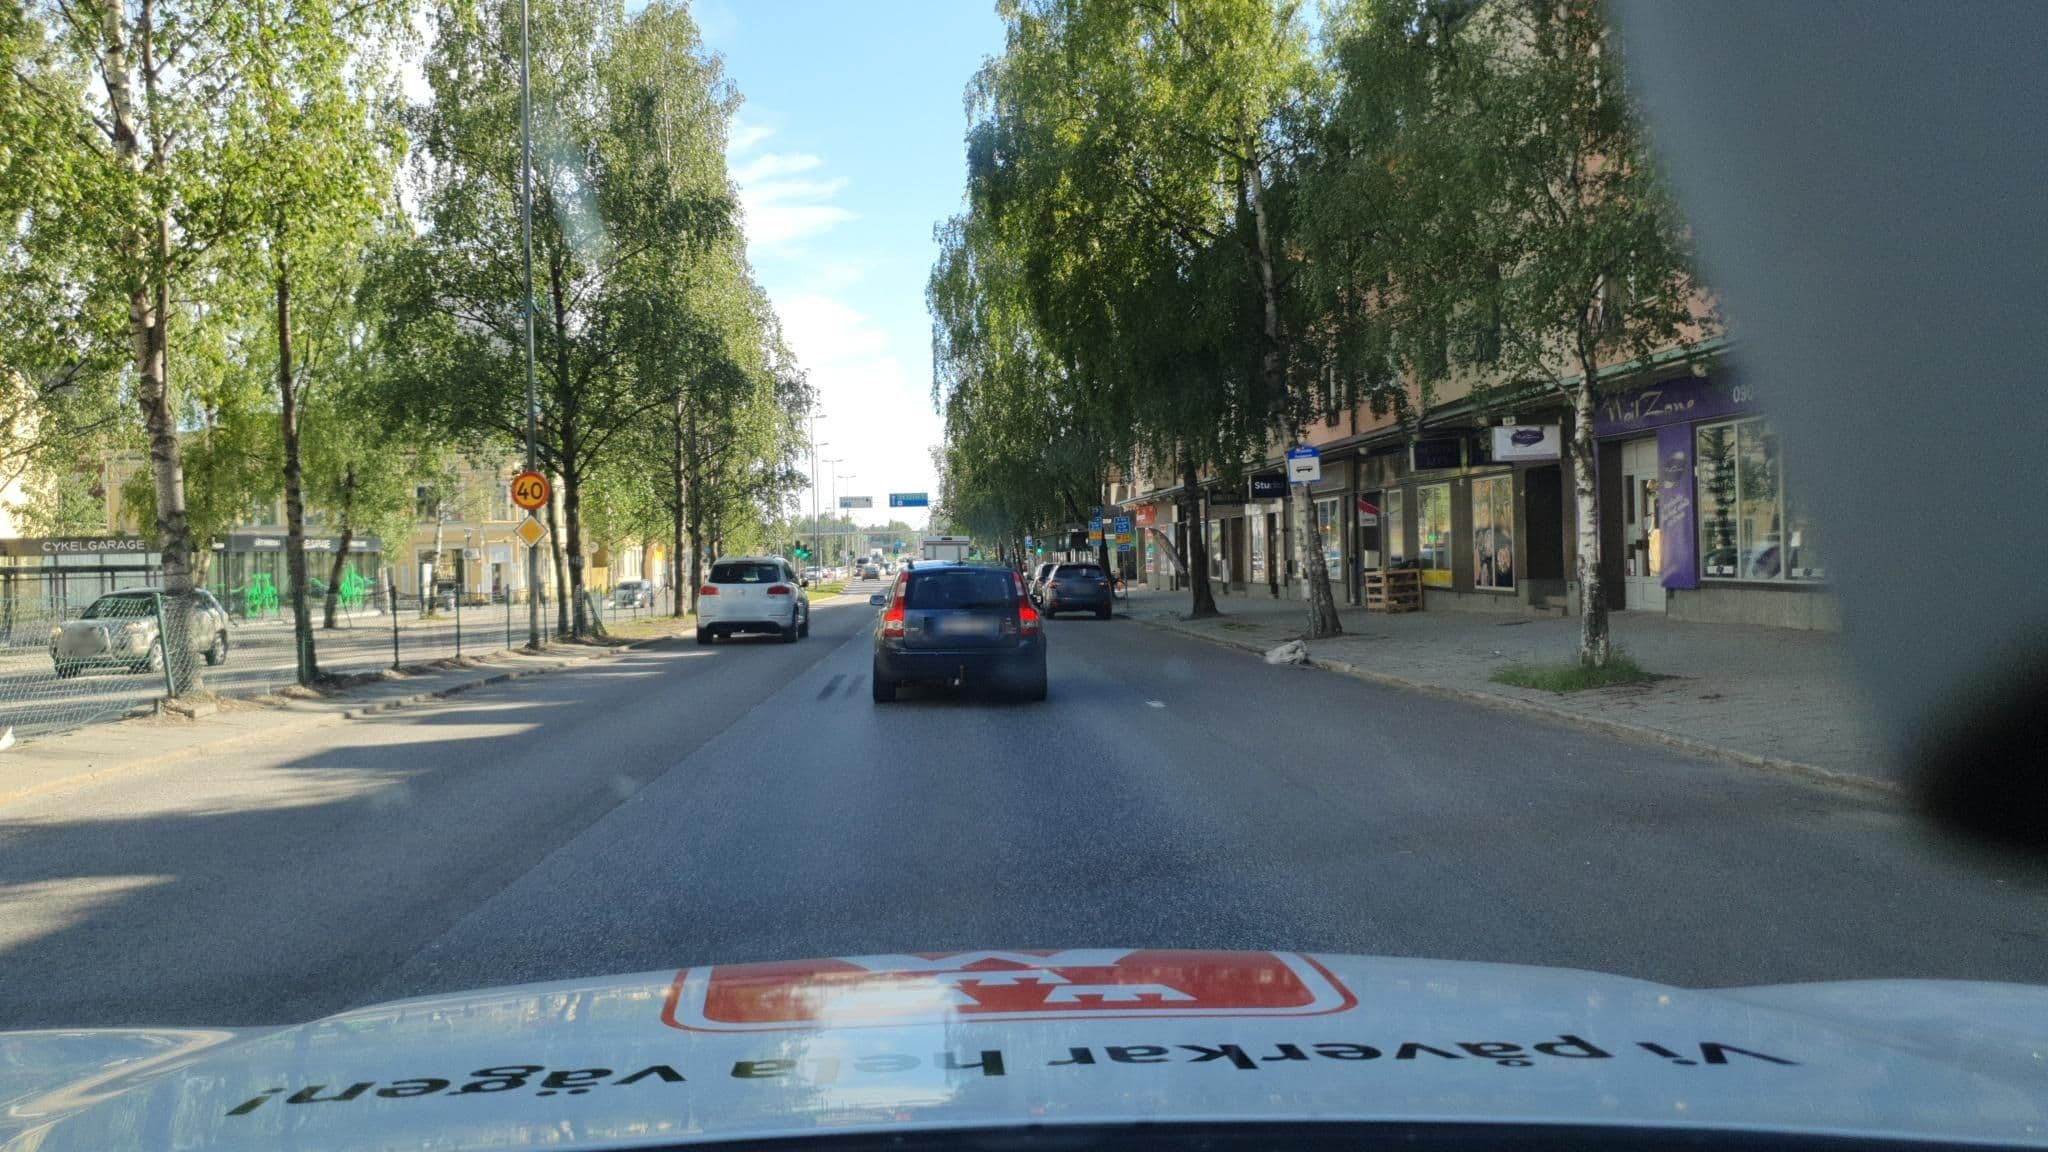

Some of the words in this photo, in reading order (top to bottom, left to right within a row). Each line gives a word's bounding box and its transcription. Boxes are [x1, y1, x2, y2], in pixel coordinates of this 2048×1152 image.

[1602, 397, 1640, 424] Nail
[1640, 391, 1696, 417] Zone
[516, 483, 543, 500] 40
[41, 539, 145, 552] CYKELGARAGE
[1047, 1034, 1614, 1070] påverkar
[1636, 1040, 1803, 1067] Vi
[225, 1062, 687, 1117] vägen!
